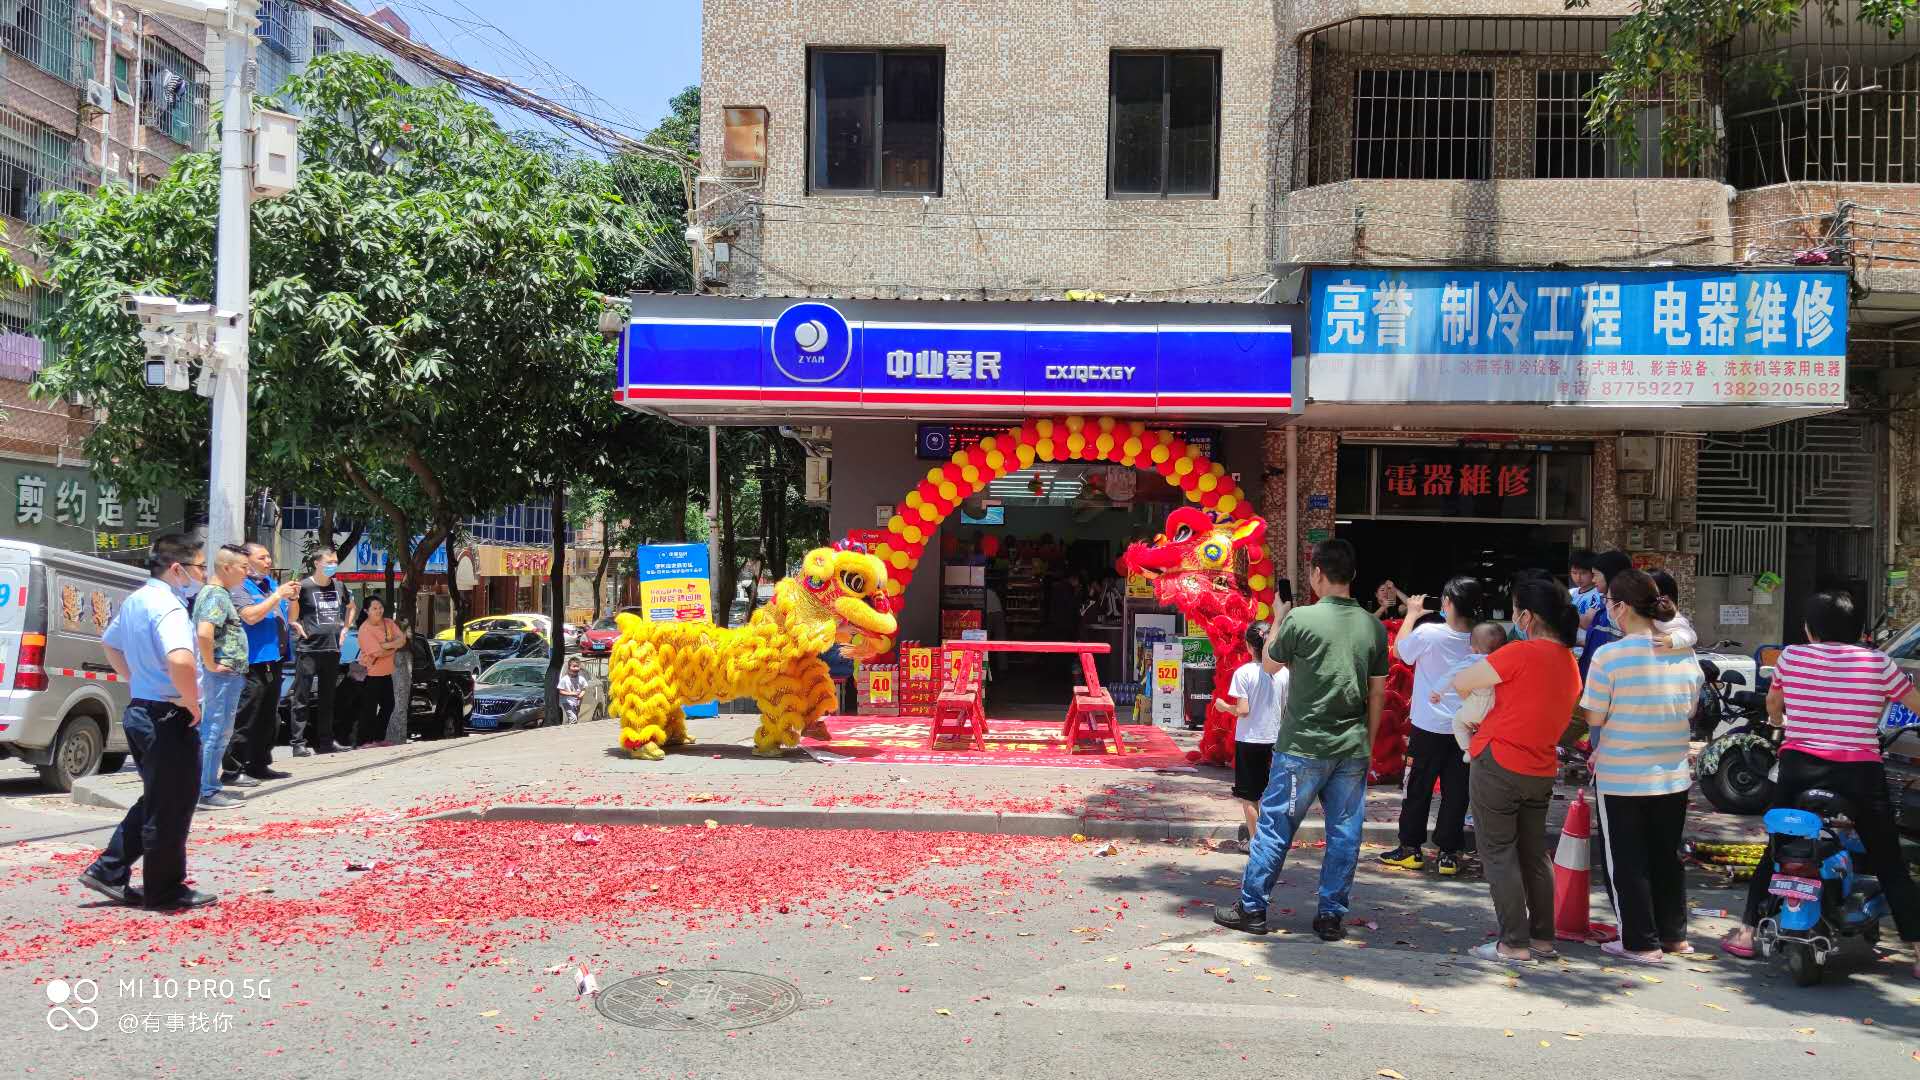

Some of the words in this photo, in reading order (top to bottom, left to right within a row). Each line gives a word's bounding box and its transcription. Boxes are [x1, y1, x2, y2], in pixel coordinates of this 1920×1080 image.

[1326, 279, 1415, 348] 亮誉
[1440, 279, 1623, 348] 制冷工程
[1652, 279, 1835, 349] 电器维修
[798, 355, 825, 364] ZYAM
[886, 348, 1002, 380] 中业爱民
[1045, 364, 1136, 384] CXJQCXGY
[1601, 381, 1695, 397] 87759227
[1712, 381, 1841, 398] 13829205682
[1383, 463, 1531, 497] 電器維修
[17, 474, 160, 528] 剪约造型
